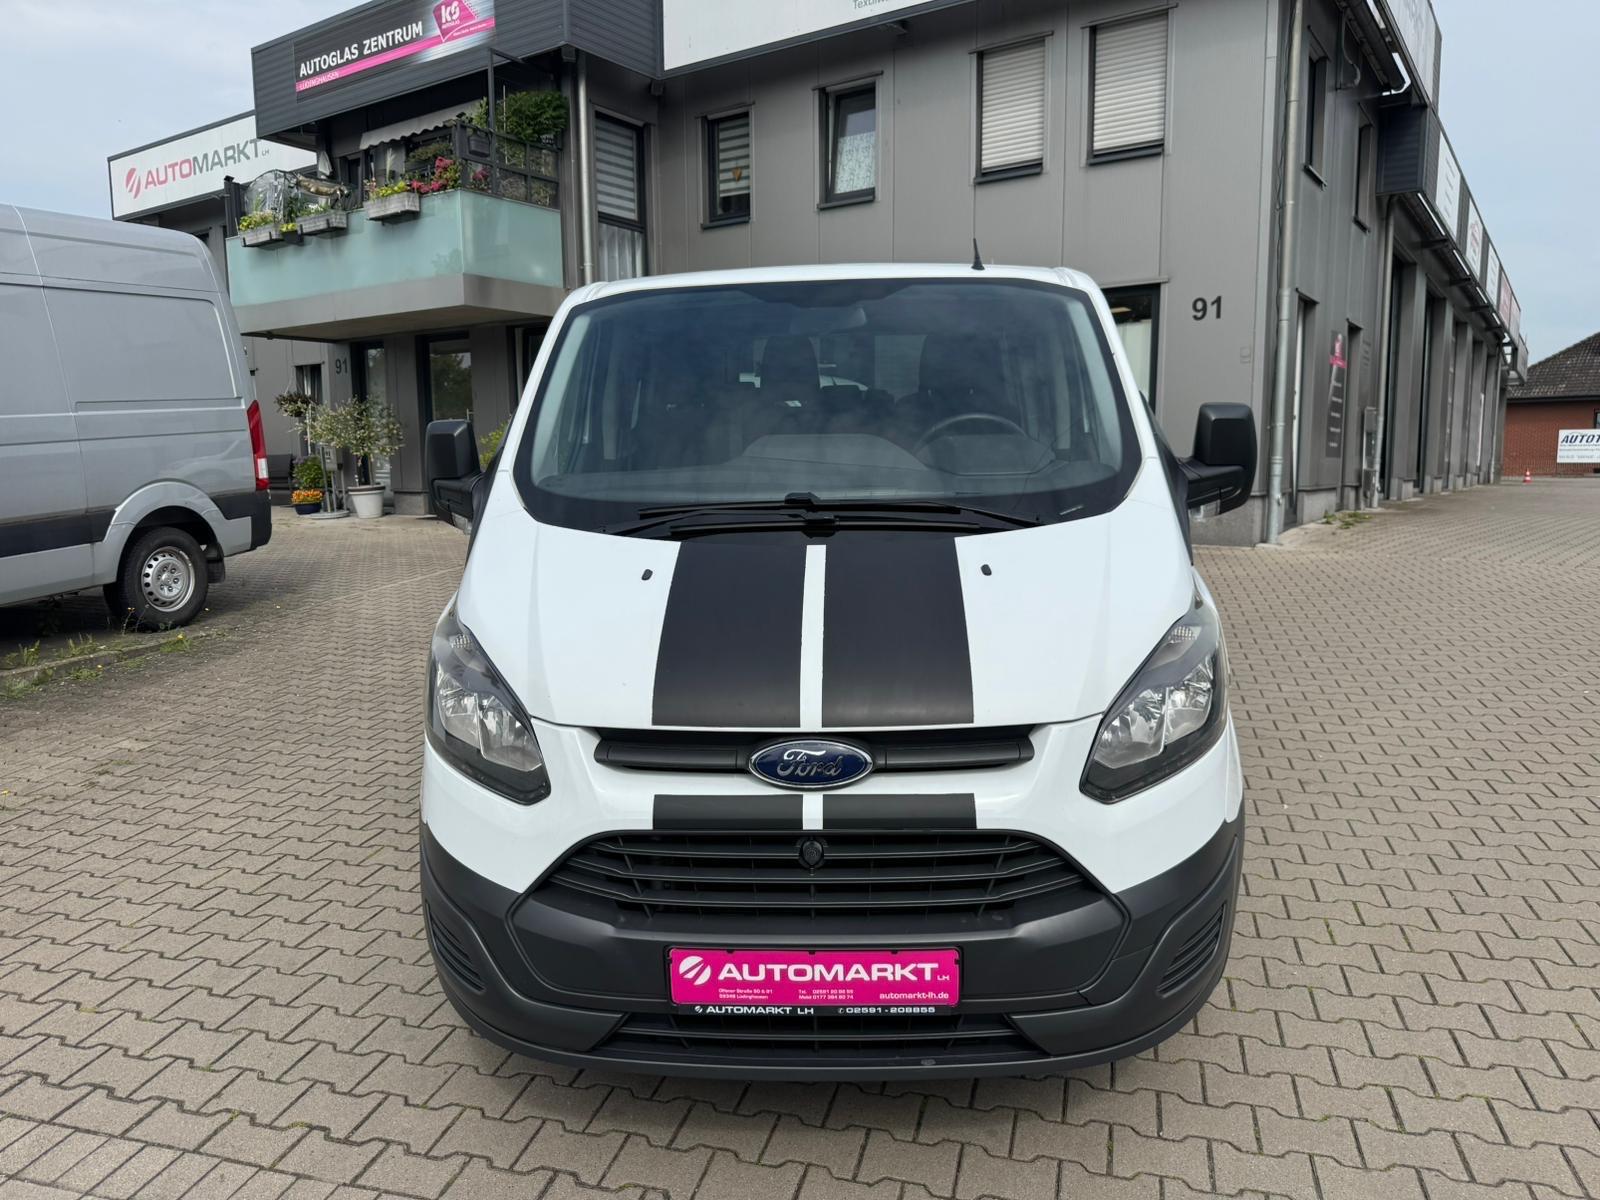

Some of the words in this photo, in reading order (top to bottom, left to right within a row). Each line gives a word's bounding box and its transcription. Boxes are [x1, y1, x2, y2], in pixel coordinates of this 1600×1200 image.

[299, 43, 359, 78] AUTOGLAS
[362, 21, 423, 56] ZENTRUM
[144, 139, 261, 190] AUTOMARKT
[1192, 295, 1222, 322] 91
[335, 357, 348, 375] 91
[776, 748, 843, 777] Ford
[718, 963, 939, 981] AUTOMARKT
[879, 992, 949, 1000] automarkt-lh.de
[706, 1006, 793, 1015] AUTOMARKT
[797, 1006, 814, 1015] LH
